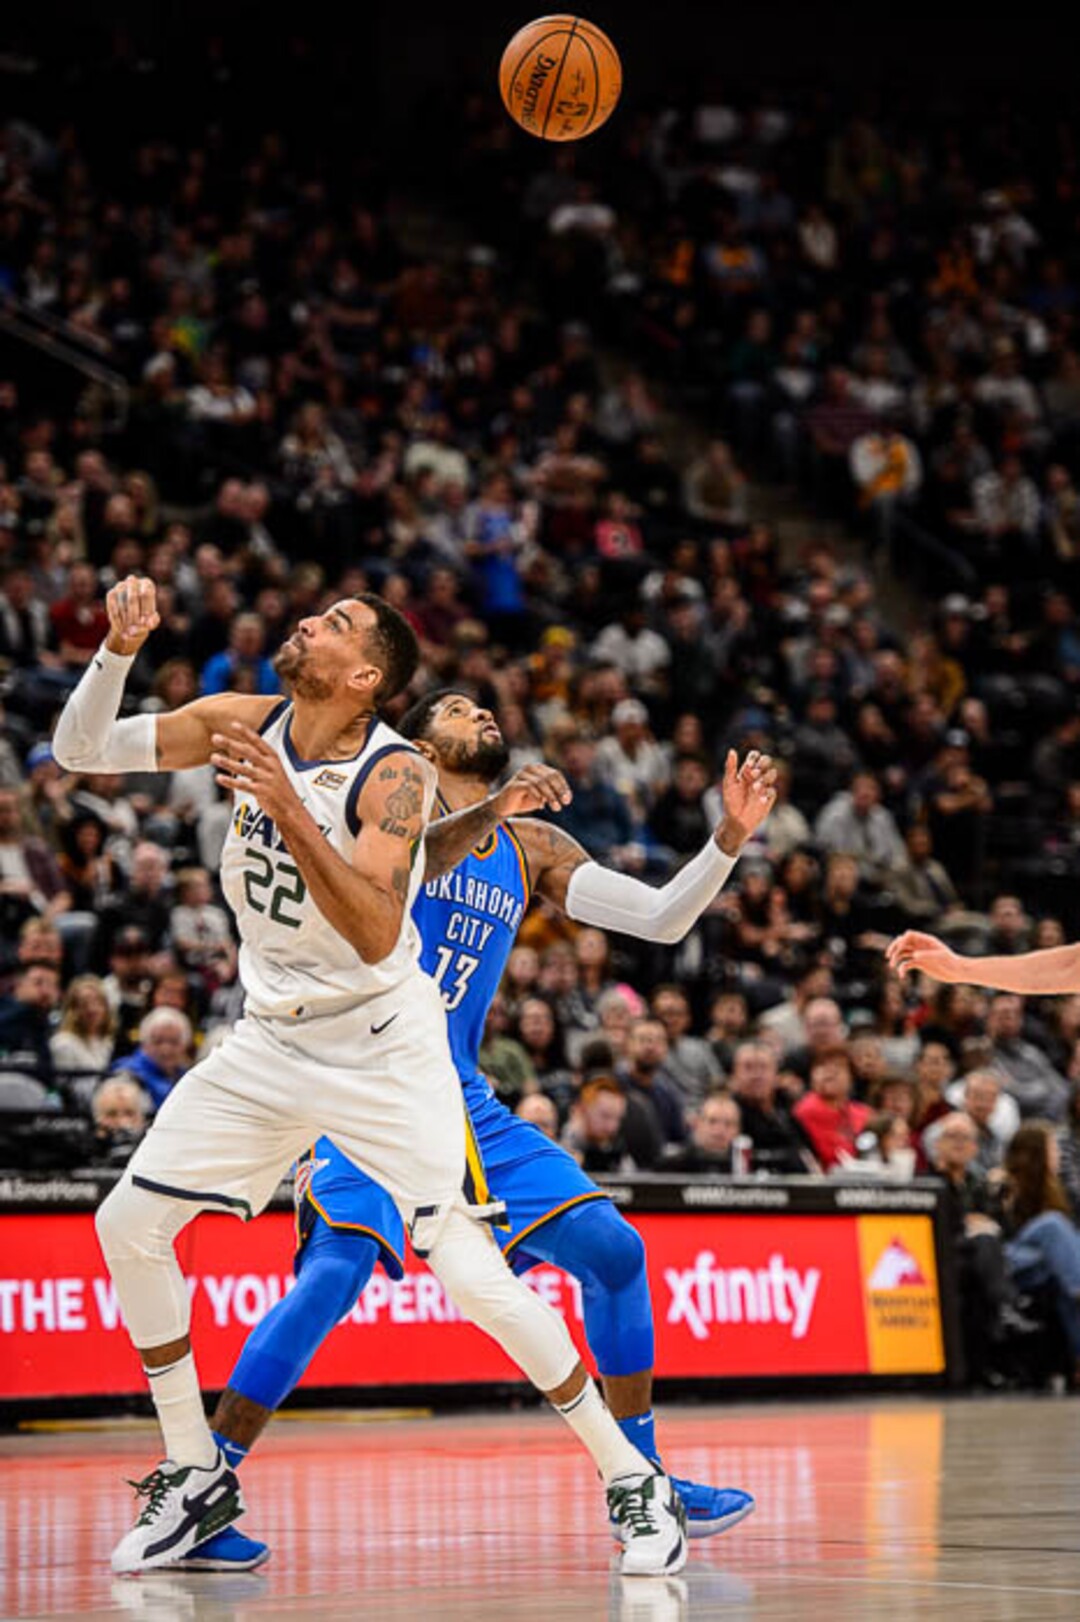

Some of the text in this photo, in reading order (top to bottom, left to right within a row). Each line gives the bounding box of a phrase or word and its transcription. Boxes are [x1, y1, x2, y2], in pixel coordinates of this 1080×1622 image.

[243, 847, 306, 928] 22
[425, 870, 524, 931] OKLAHOMA
[446, 912, 494, 951] CITY
[433, 945, 480, 1011] 13
[0, 1279, 86, 1332] THE
[664, 1250, 821, 1339] xfinity
